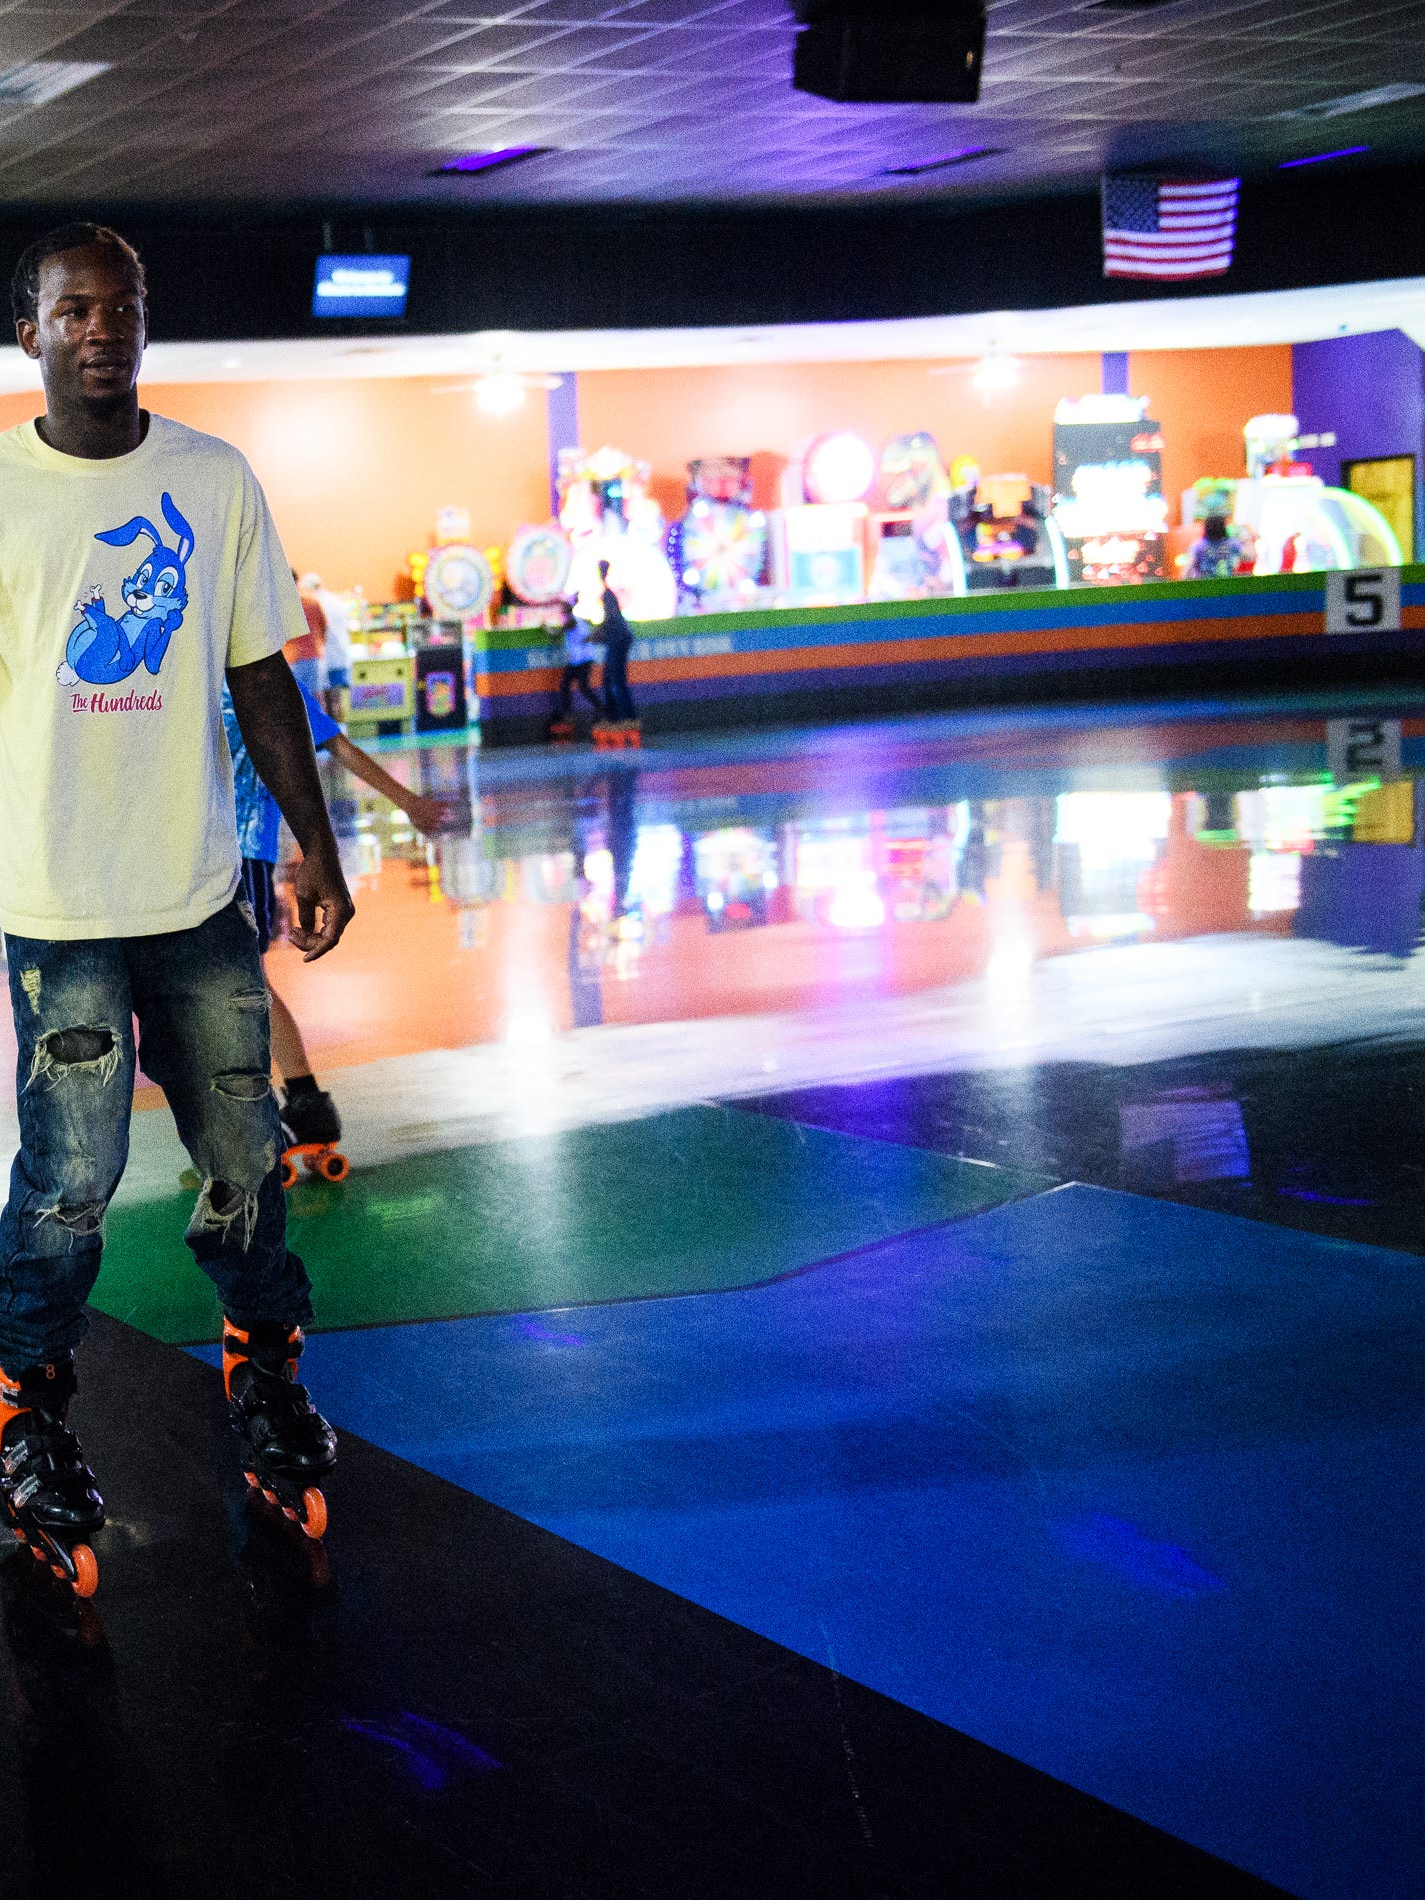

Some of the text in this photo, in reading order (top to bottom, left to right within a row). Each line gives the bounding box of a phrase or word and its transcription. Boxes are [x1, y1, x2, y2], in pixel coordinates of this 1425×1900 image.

[1344, 574, 1384, 626] 5
[70, 689, 163, 713] The Hundreds
